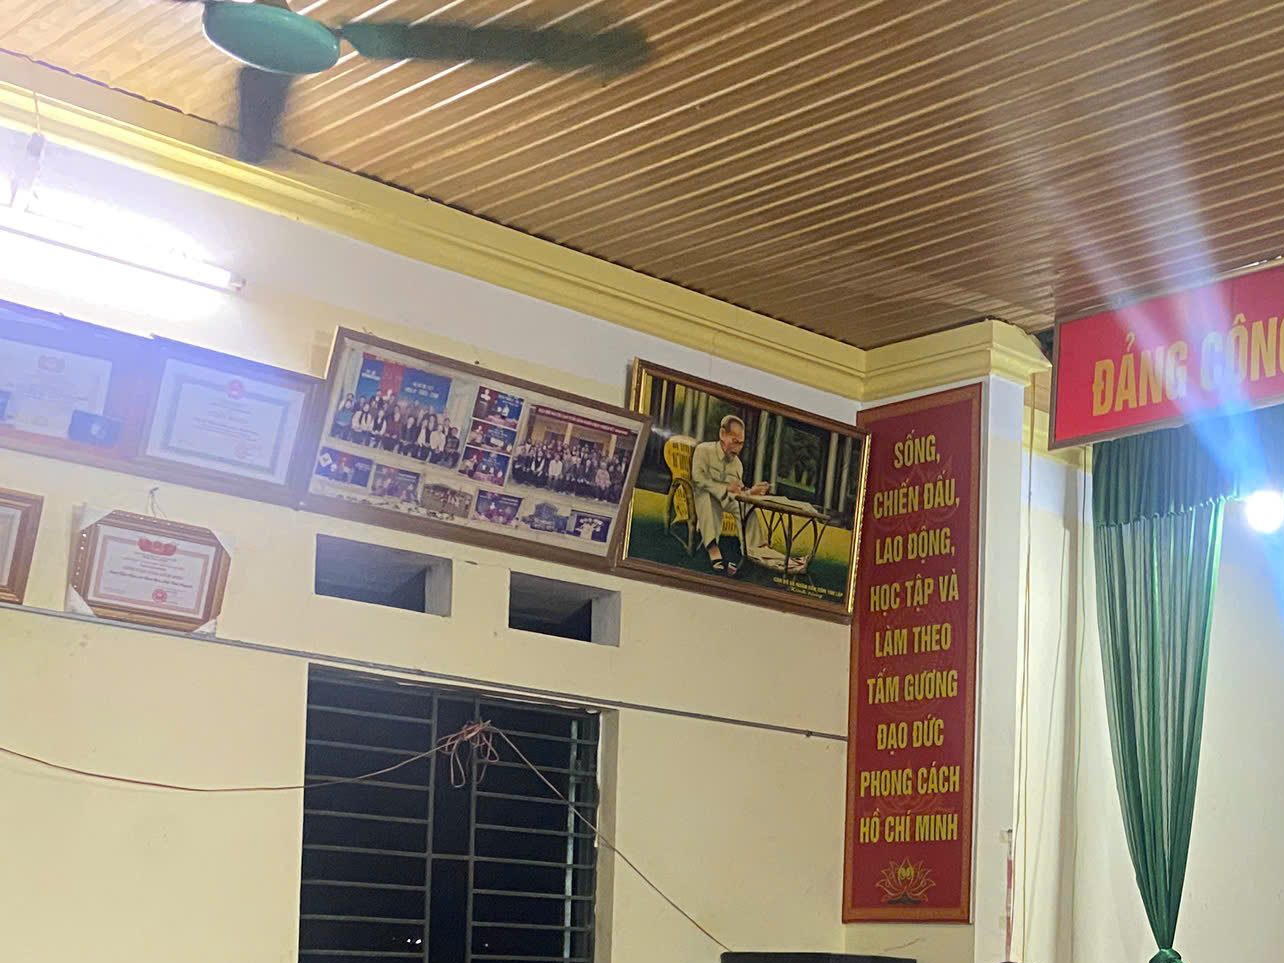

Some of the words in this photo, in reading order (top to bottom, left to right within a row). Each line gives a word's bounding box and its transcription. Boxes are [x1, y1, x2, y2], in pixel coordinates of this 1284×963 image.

[1092, 331, 1189, 417] ĐẢNG
[894, 429, 940, 468] SỐNG,
[873, 478, 920, 519] CHIẾN
[924, 470, 960, 510] ĐẤU,
[875, 535, 903, 565] LAO
[908, 525, 955, 564] ĐỘNG,
[870, 583, 901, 616] HỌC
[905, 573, 934, 612] TẬP
[939, 568, 959, 602] VÀ
[875, 625, 908, 658] LÀM
[912, 622, 952, 653] THEO
[867, 668, 899, 705] TẤM
[904, 669, 958, 701] GƯƠNG
[877, 721, 908, 755] ĐẠO
[912, 713, 945, 748] ĐỨC
[860, 768, 912, 797] PHONG
[917, 761, 960, 794] CÁCH
[860, 808, 880, 843] HỒ
[885, 811, 910, 842] CHÍ
[915, 813, 958, 841] MINH
